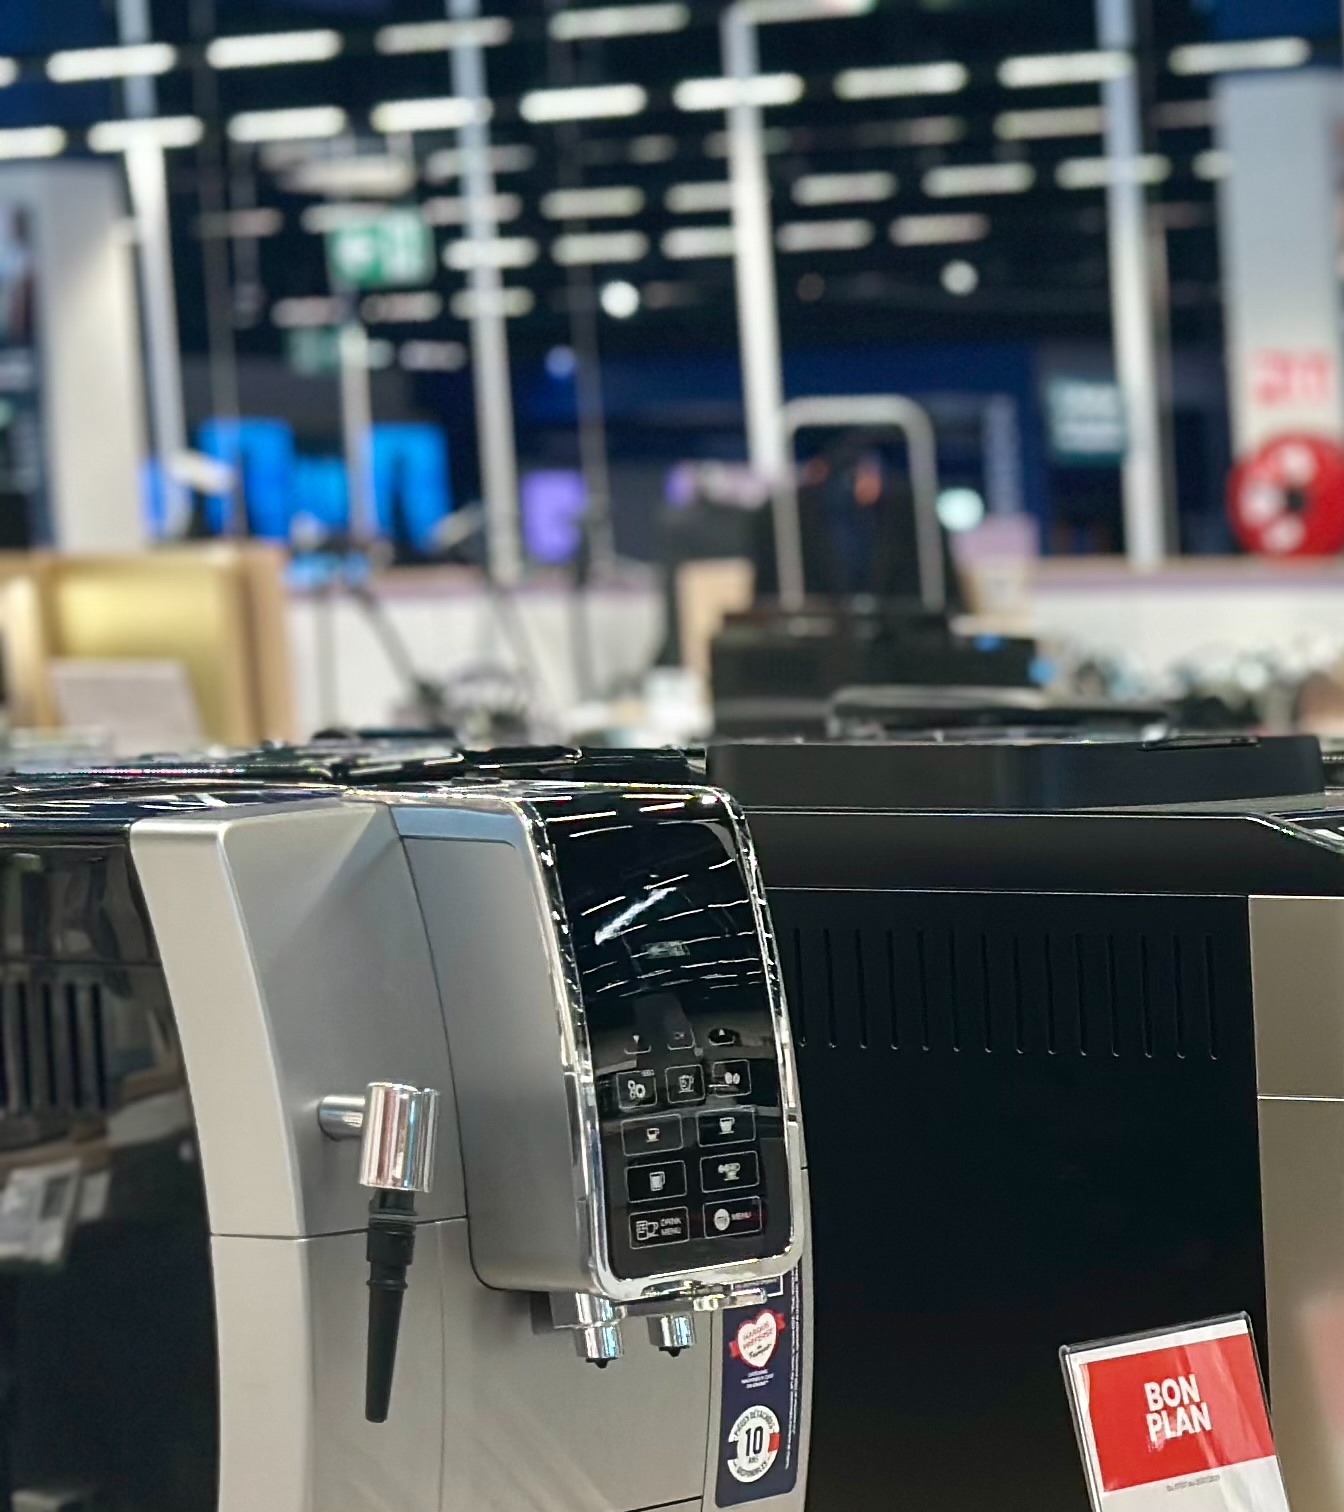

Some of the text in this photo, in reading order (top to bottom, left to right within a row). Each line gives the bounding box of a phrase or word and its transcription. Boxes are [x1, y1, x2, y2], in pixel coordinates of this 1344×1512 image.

[1144, 1374, 1200, 1412] BON
[1146, 1402, 1212, 1442] PLAN
[746, 1426, 763, 1457] 10
